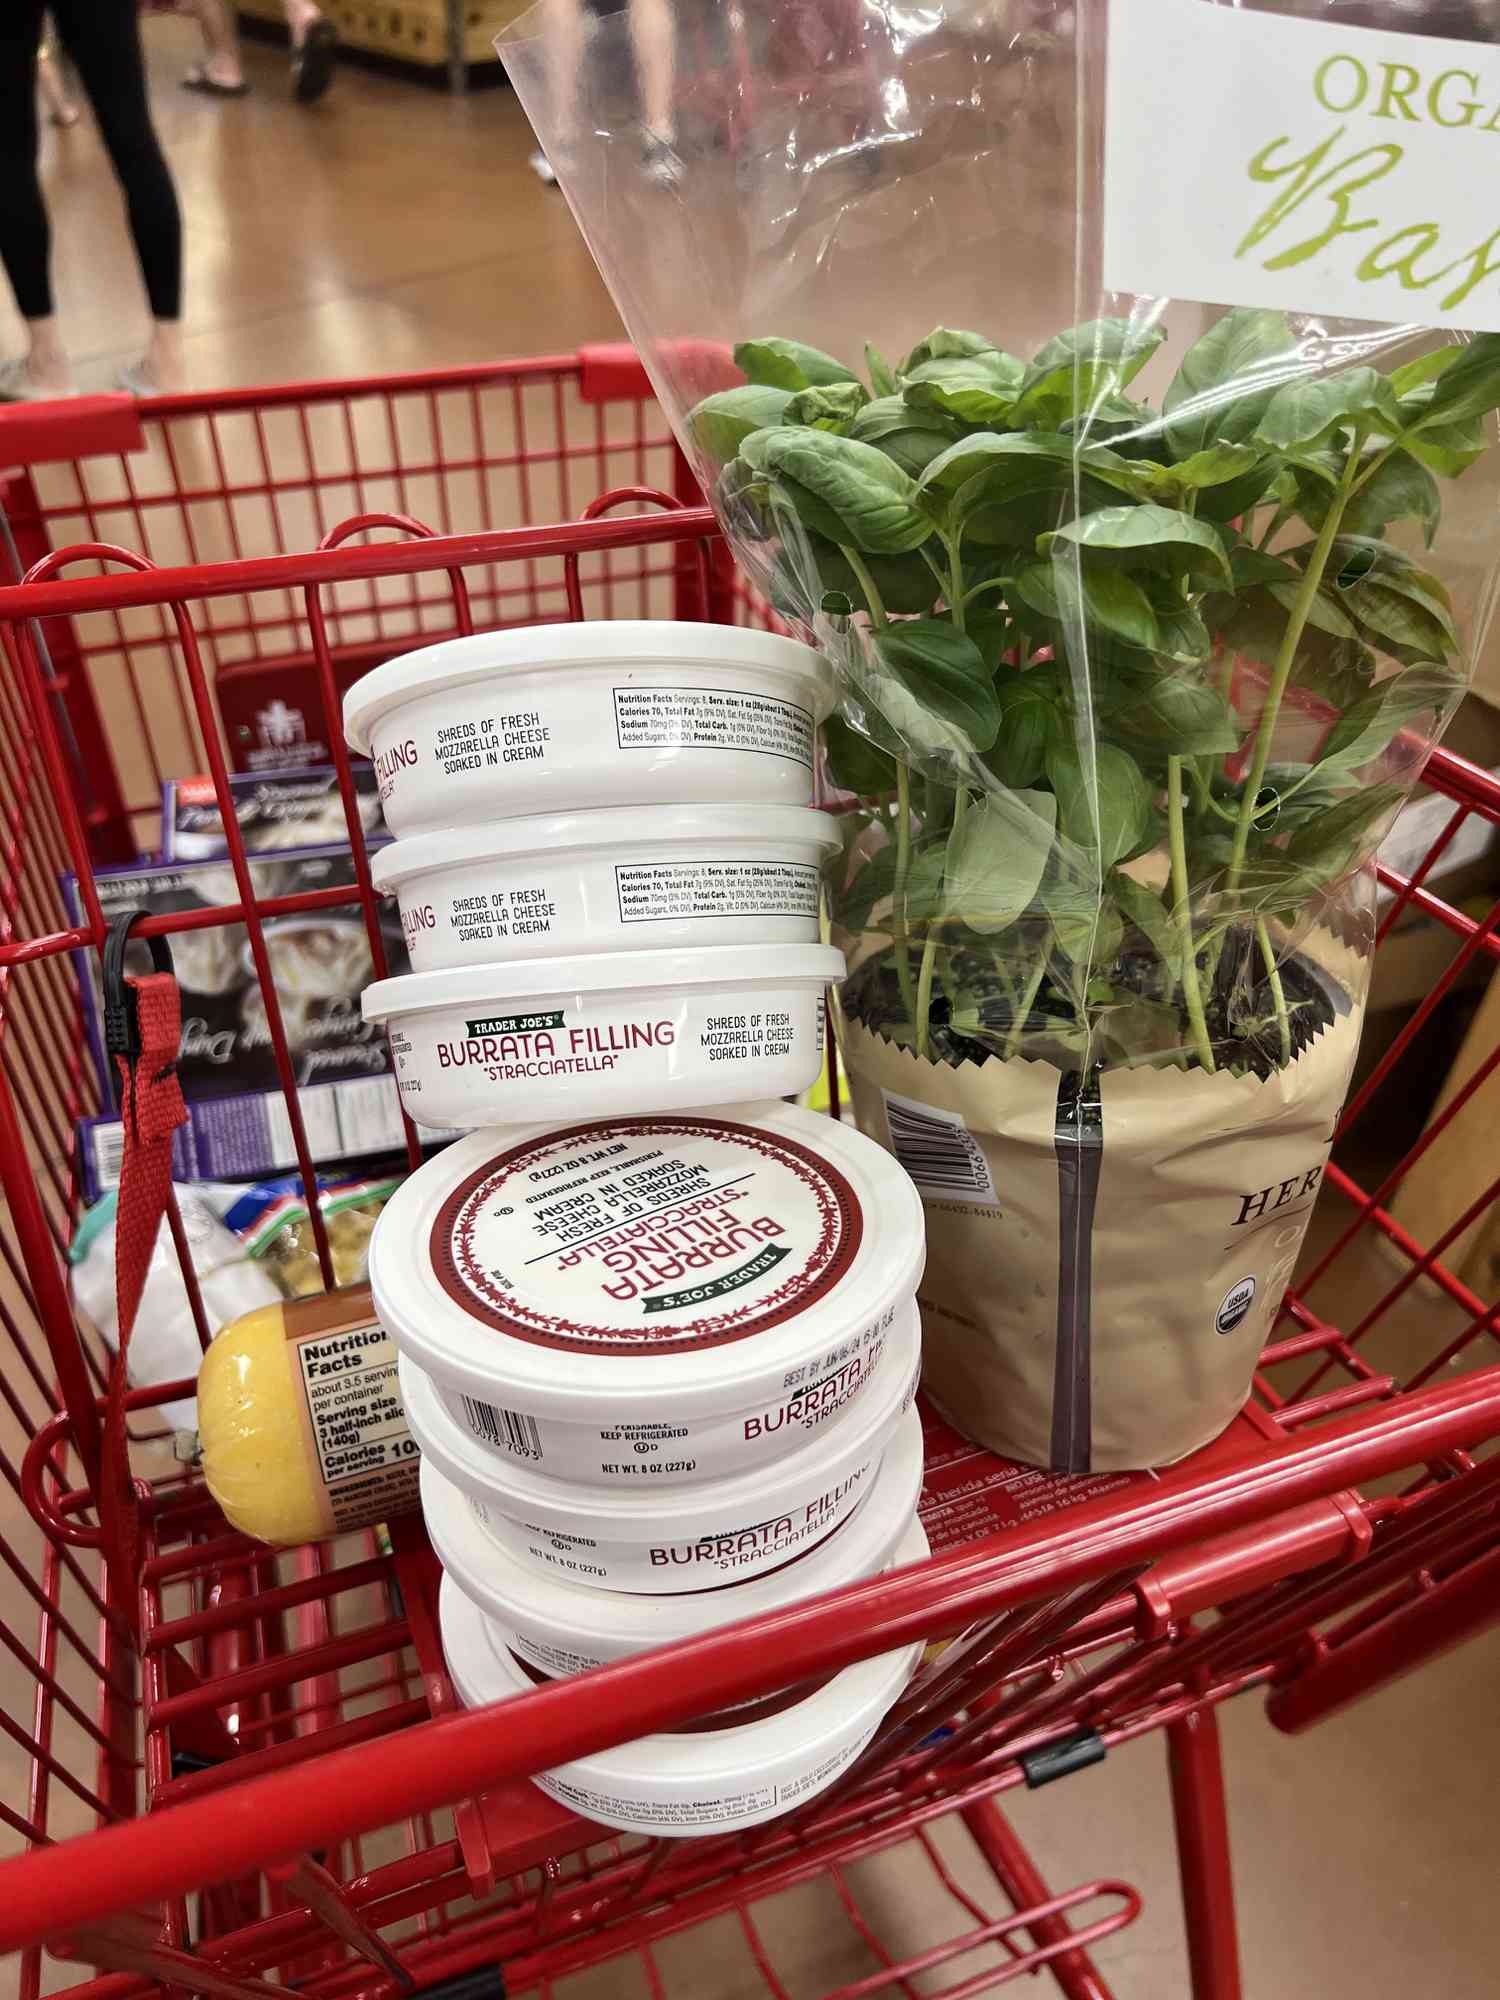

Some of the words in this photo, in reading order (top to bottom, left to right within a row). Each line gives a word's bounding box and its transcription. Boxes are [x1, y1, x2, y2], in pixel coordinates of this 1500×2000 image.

[1313, 53, 1500, 132] ORG
[618, 694, 652, 704] Nutrition
[653, 694, 672, 703] Facts
[619, 707, 650, 717] Calories
[665, 707, 682, 716] Total
[683, 707, 695, 716] Fat
[437, 722, 475, 743] SHREDS
[481, 719, 495, 733] OF
[501, 712, 540, 730] FRESH
[620, 720, 648, 729] Sodium
[695, 720, 711, 729] Total
[712, 721, 728, 731] Carb.
[434, 735, 499, 760] MOZZARELLA
[505, 728, 550, 745] CHEESE
[694, 733, 717, 742] Protein
[444, 755, 481, 775] SOAKED
[487, 752, 498, 766] IN
[503, 745, 544, 763] CREAM
[620, 871, 652, 881] Nutrition
[653, 869, 672, 878] Facts
[708, 868, 724, 876] Serv.
[621, 882, 650, 892] Calories
[652, 882, 664, 892] 70,
[665, 881, 682, 890] Total
[683, 880, 695, 889] Fat
[453, 896, 487, 912] SHREDS
[492, 894, 504, 906] OF
[510, 888, 546, 904] FRESH
[622, 895, 649, 904] Sodium
[694, 891, 711, 900] Total
[711, 891, 728, 899] Carb.
[450, 908, 509, 928] MOZZARELLA
[513, 903, 556, 920] CHEESE
[623, 906, 645, 916] Added
[693, 903, 716, 911] Protein
[458, 925, 493, 942] SOAKED
[497, 923, 508, 936] IN
[512, 919, 551, 936] CREAM
[474, 1019, 517, 1034] TRADER
[519, 1014, 553, 1029] JOE'S
[706, 1015, 746, 1031] SHREDS
[750, 1014, 762, 1028] OF
[766, 1013, 790, 1027] FRESH
[437, 1031, 554, 1068] BURRATA
[569, 1020, 675, 1053] FILLING
[700, 1029, 764, 1047] MOZZARELLA
[766, 1027, 795, 1042] CHEESE
[709, 1046, 747, 1061] SOAKED
[751, 1045, 761, 1057] IN
[764, 1043, 790, 1056] CREAM
[578, 1156, 587, 1165] 8
[586, 1148, 606, 1162] WT.
[606, 1143, 629, 1156] NET
[608, 1150, 664, 1171] PERISHABLE,
[528, 1162, 563, 1183] (227g)
[564, 1159, 578, 1169] OZ
[589, 1167, 609, 1182] KEEP
[622, 1158, 686, 1188] SOAKED
[525, 1174, 590, 1204] REFRIGERATED
[598, 1183, 620, 1196] IN
[603, 1164, 710, 1208] MOZZARELLA
[650, 1177, 711, 1206] SHREDS
[533, 1192, 596, 1221] CREAM
[624, 1201, 644, 1217] OF
[532, 1204, 601, 1237] CHEESE
[556, 1213, 615, 1243] FRESH
[602, 1208, 741, 1273] FILLING
[601, 1215, 786, 1301] BURRATA
[718, 1252, 778, 1294] TRADER
[663, 1287, 714, 1308] JOE'S
[1227, 1287, 1250, 1309] USDA
[307, 1353, 363, 1379] Facts
[783, 1365, 806, 1388] BEST
[311, 1383, 342, 1399] about
[344, 1376, 362, 1390] 3.5
[313, 1399, 332, 1414] per
[334, 1384, 384, 1406] container
[317, 1405, 367, 1426] Serving
[370, 1396, 397, 1411] size
[744, 1358, 861, 1441] BURRATA
[319, 1428, 328, 1439] 3
[330, 1414, 382, 1436] half-inch
[384, 1407, 406, 1421] slic
[600, 1431, 622, 1441] KEEP
[624, 1428, 689, 1441] REFRIGERATED
[321, 1433, 360, 1452] (140g)
[324, 1444, 386, 1469] Calories
[326, 1466, 345, 1479] per
[346, 1456, 385, 1471] serving
[601, 1463, 621, 1474] NET
[622, 1463, 640, 1474] WT.
[641, 1464, 648, 1474] 8
[650, 1463, 664, 1473] OZ
[665, 1459, 696, 1473] (227g)
[650, 1517, 792, 1567] BURRATA
[529, 1546, 544, 1559] NET
[559, 1556, 566, 1567] 8
[566, 1559, 577, 1570] OZ
[579, 1561, 608, 1577] (227g)
